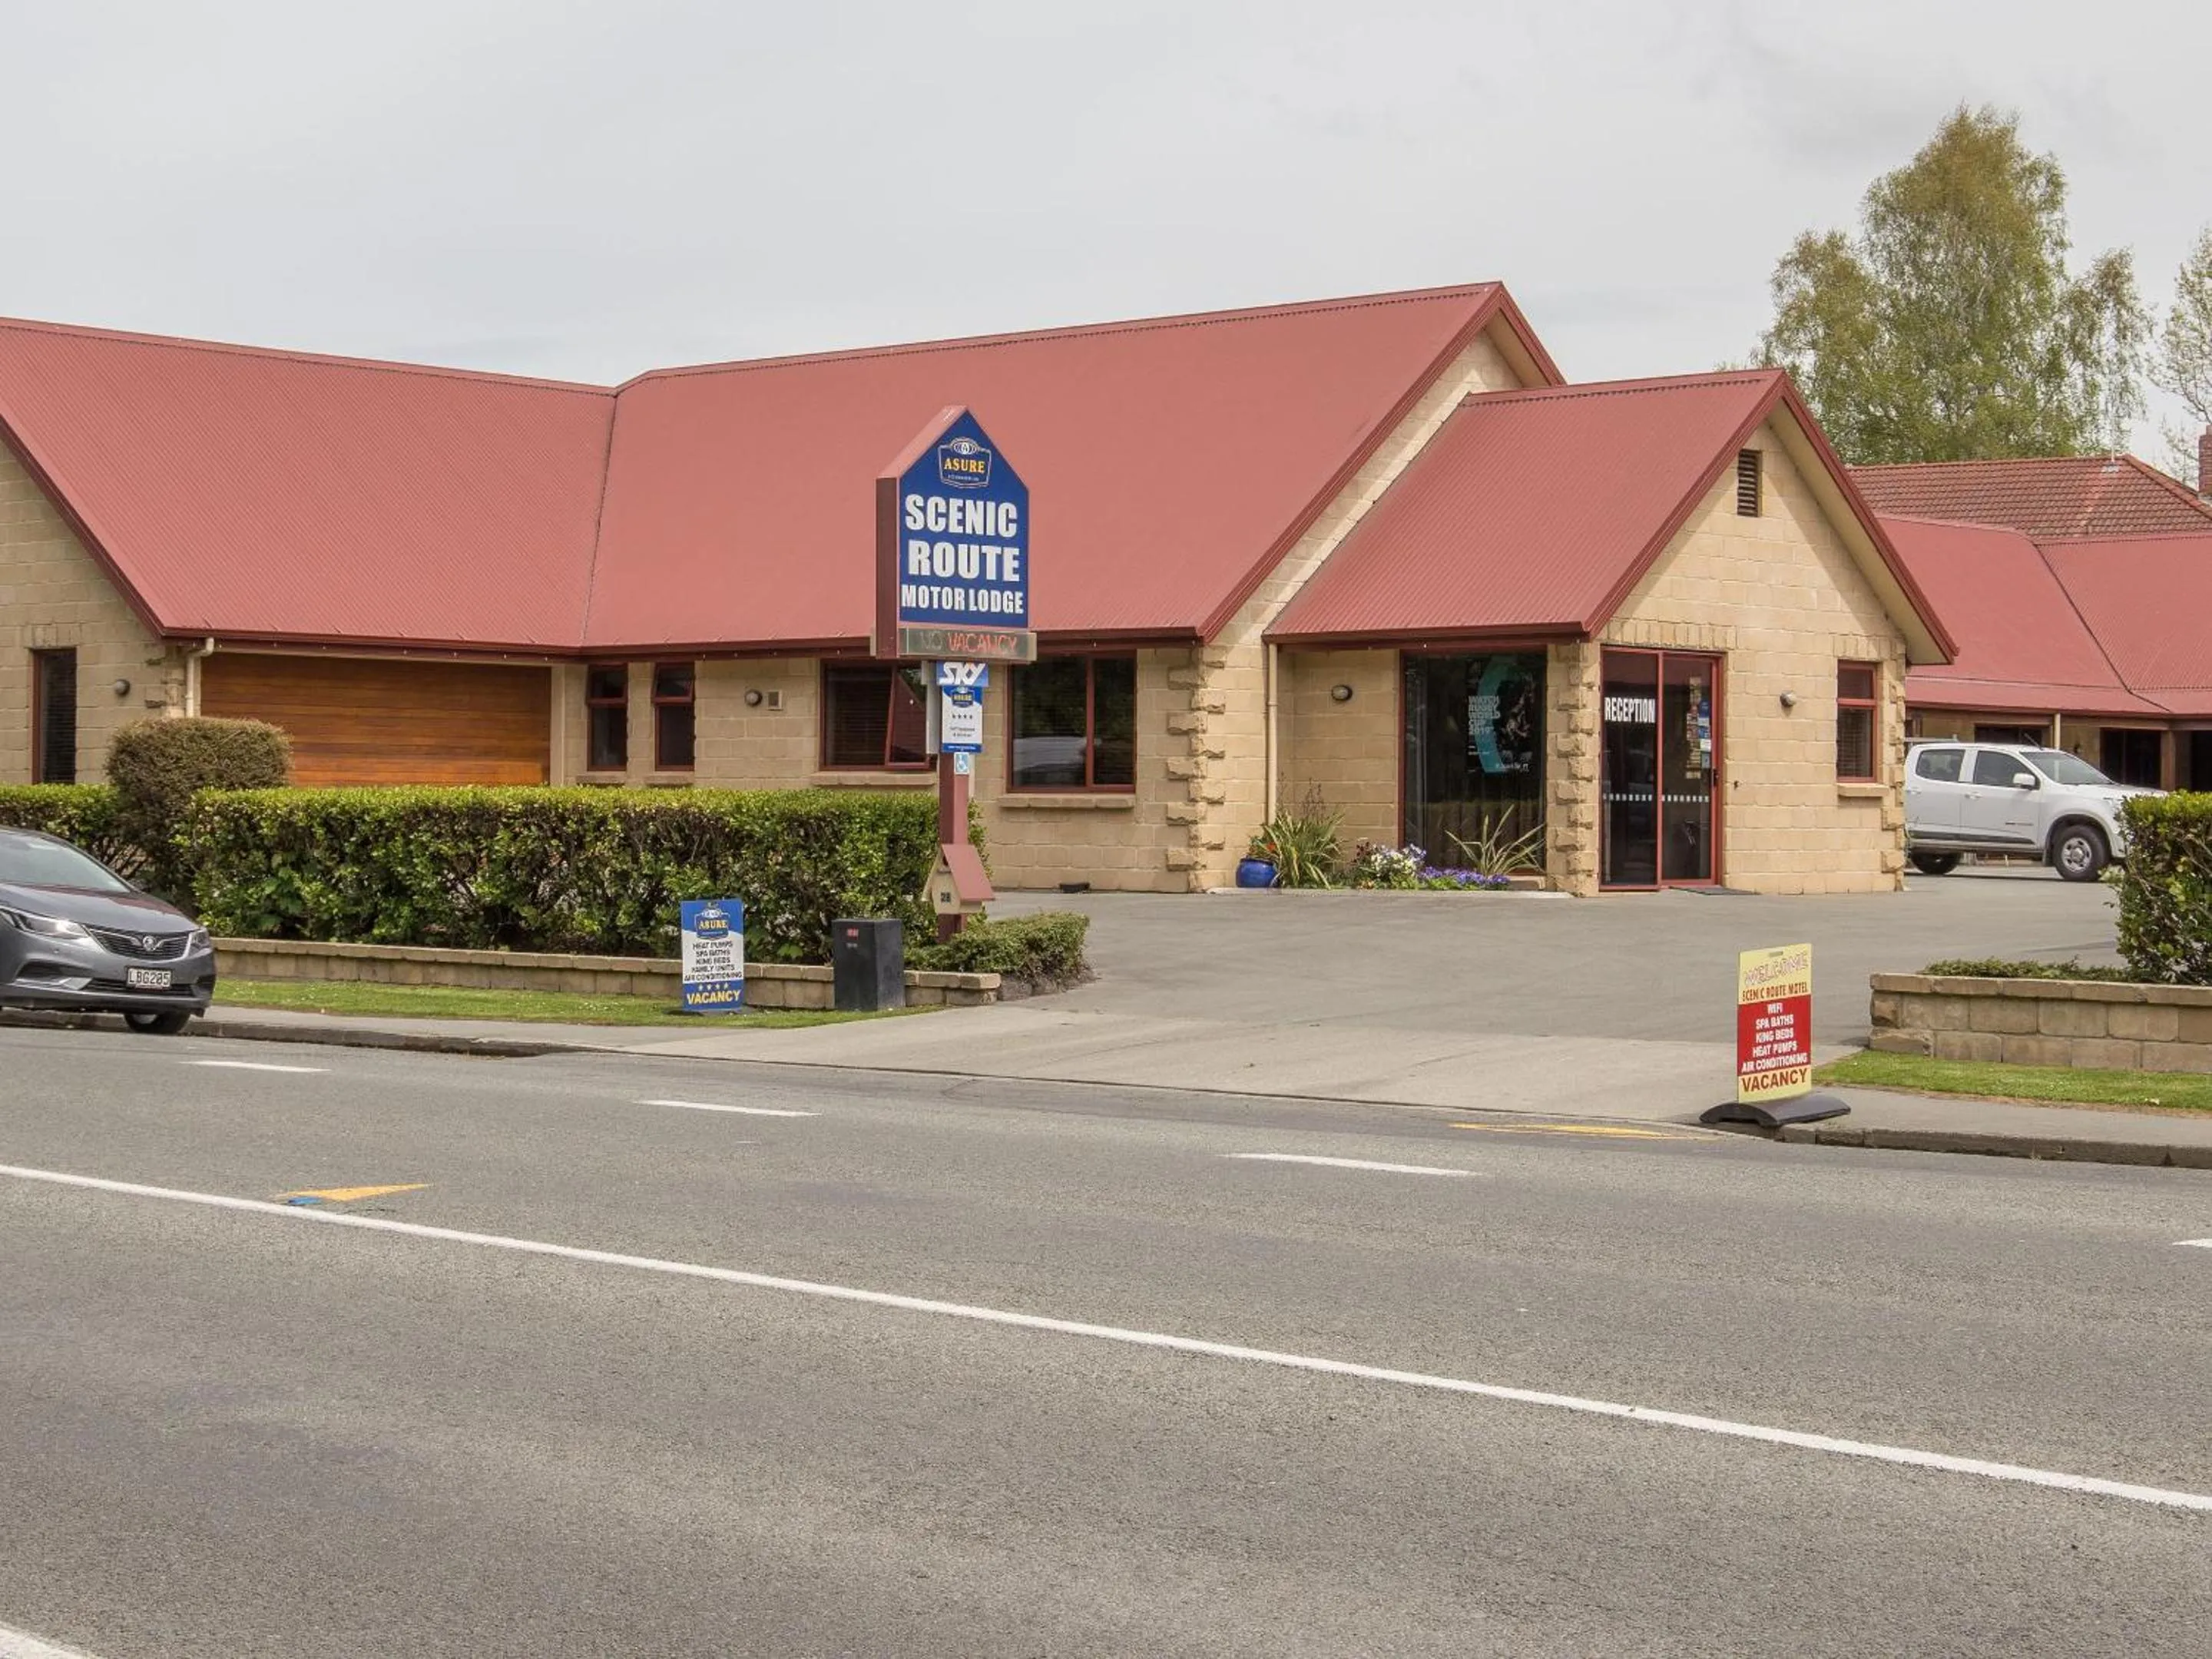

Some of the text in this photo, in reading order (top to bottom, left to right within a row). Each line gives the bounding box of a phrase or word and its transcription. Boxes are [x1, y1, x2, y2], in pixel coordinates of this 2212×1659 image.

[944, 458, 985, 473] ASURE
[905, 494, 1018, 538] SCENIC
[908, 539, 1019, 581] ROUTE
[902, 584, 1024, 614] MOTOR LODGE
[920, 631, 1018, 654] NO VACANCY
[939, 661, 986, 685] SKY
[1604, 697, 1655, 723] RECEPTION
[699, 920, 727, 929] ASURE
[687, 989, 741, 1005] VACANCY
[1742, 982, 1807, 1002] SCENIC ROUTE MOTEL
[1756, 1014, 1793, 1030] SPA BATHS
[1756, 1028, 1793, 1044] KING BEDS
[1753, 1041, 1796, 1058] HEAT PUMPS
[1742, 1053, 1807, 1073] AIR CONDITIONING
[1742, 1068, 1807, 1092] VACANCY
